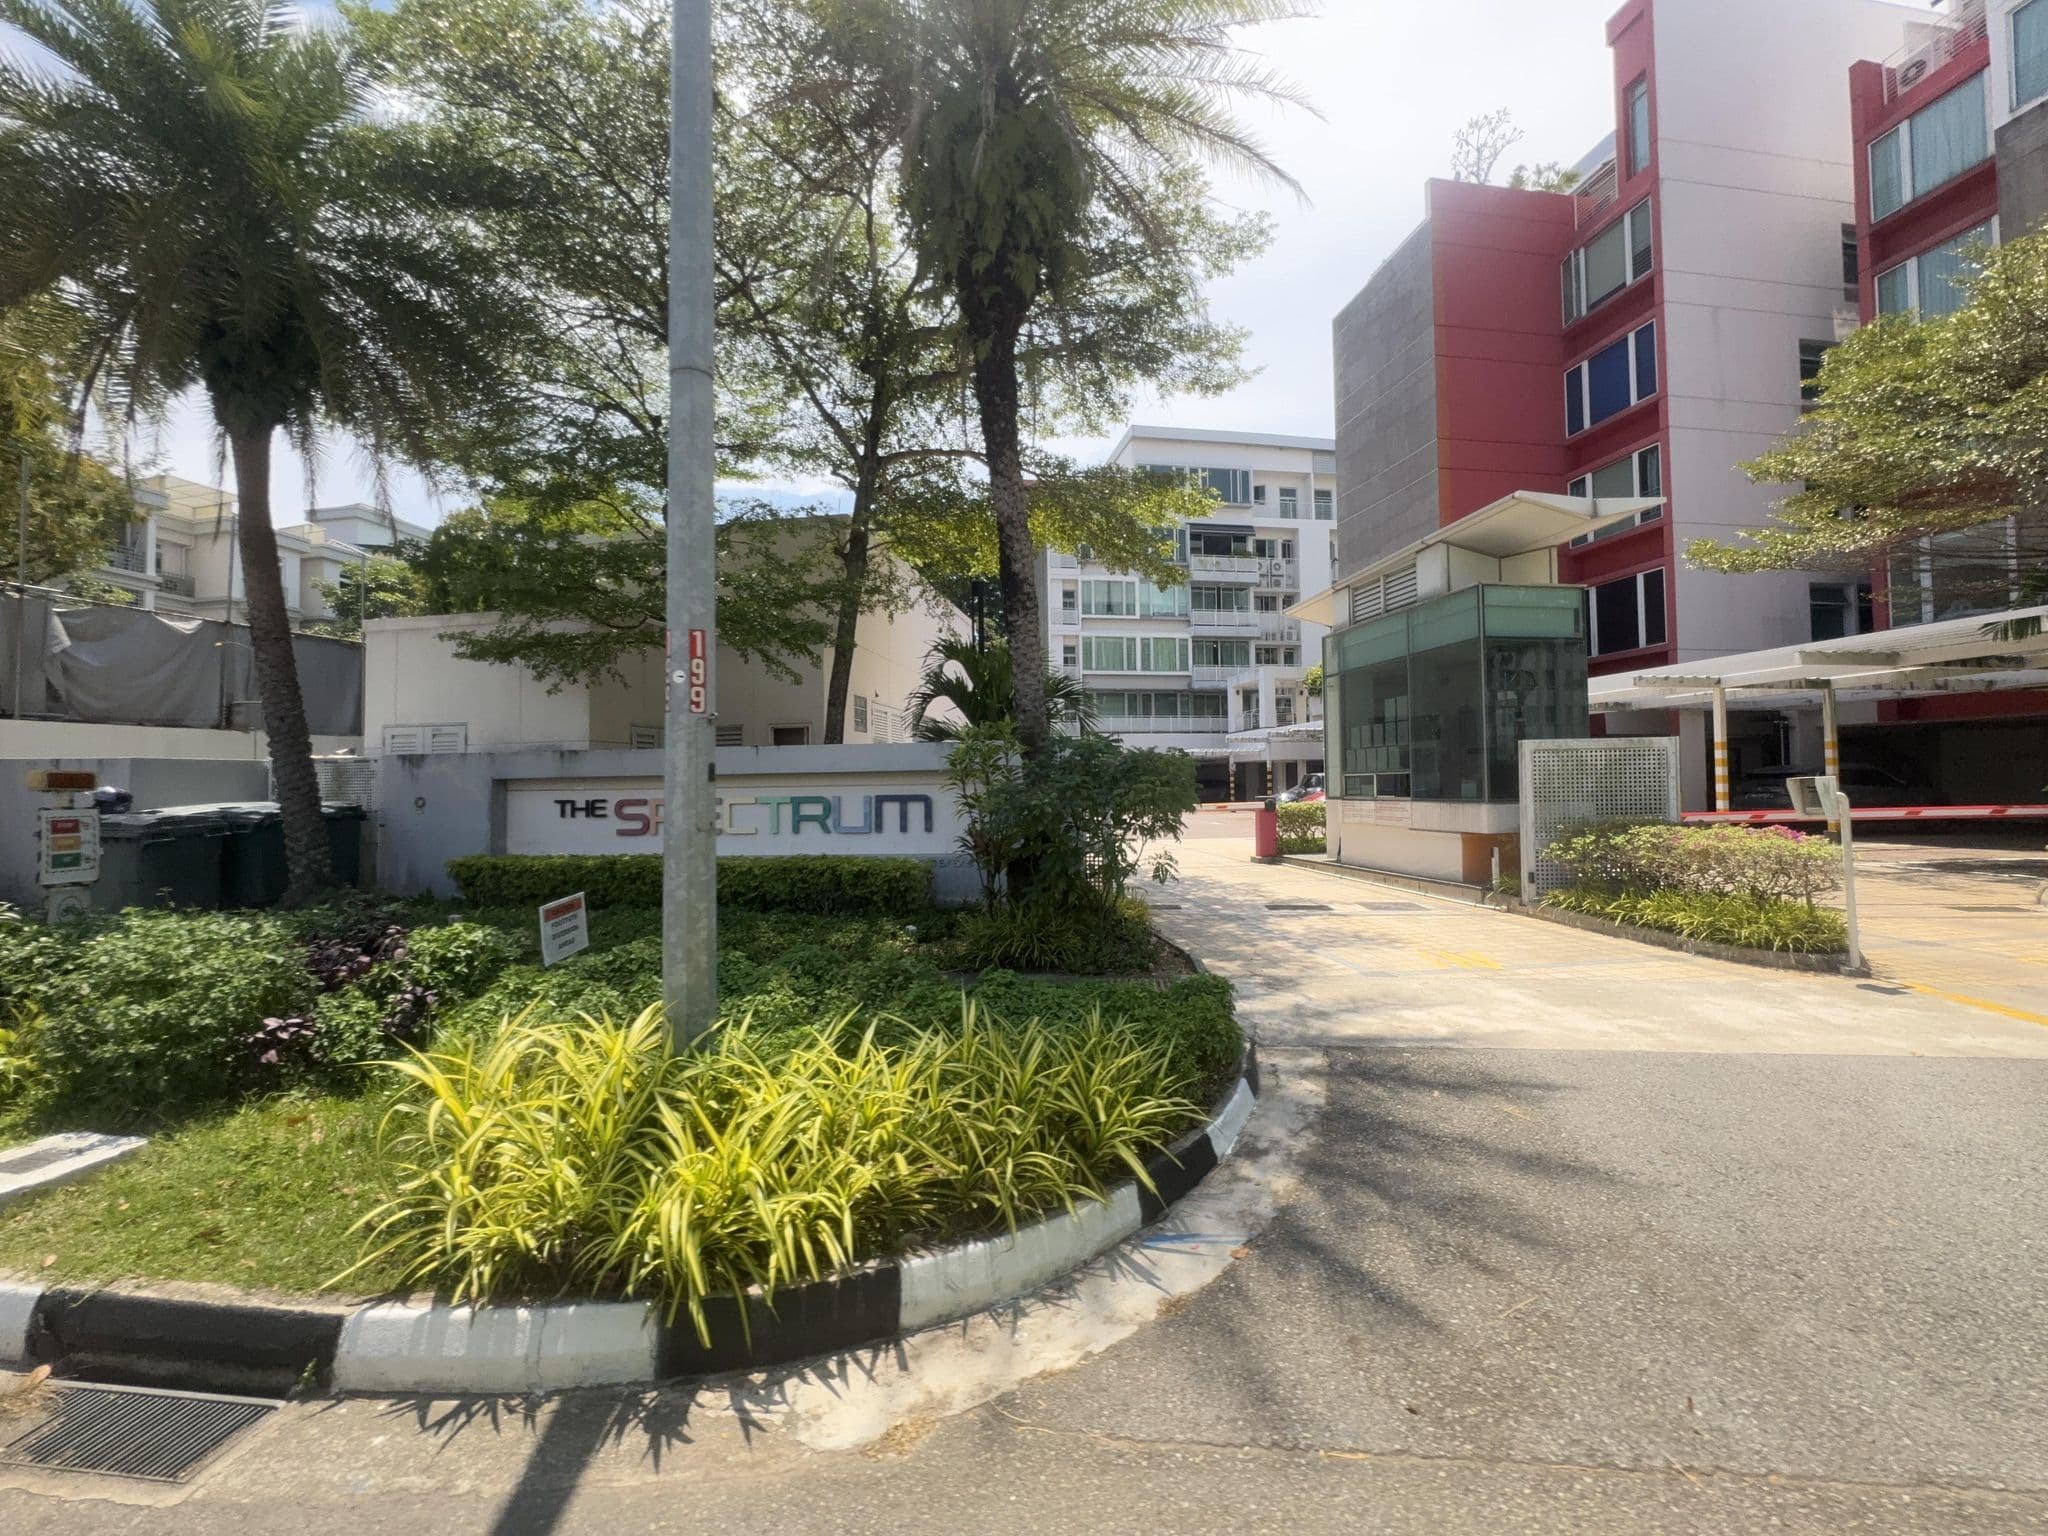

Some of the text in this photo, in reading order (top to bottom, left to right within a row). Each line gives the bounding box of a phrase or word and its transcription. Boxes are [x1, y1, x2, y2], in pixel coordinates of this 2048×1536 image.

[690, 630, 706, 713] 199
[554, 794, 933, 836] THE SPCTRUM
